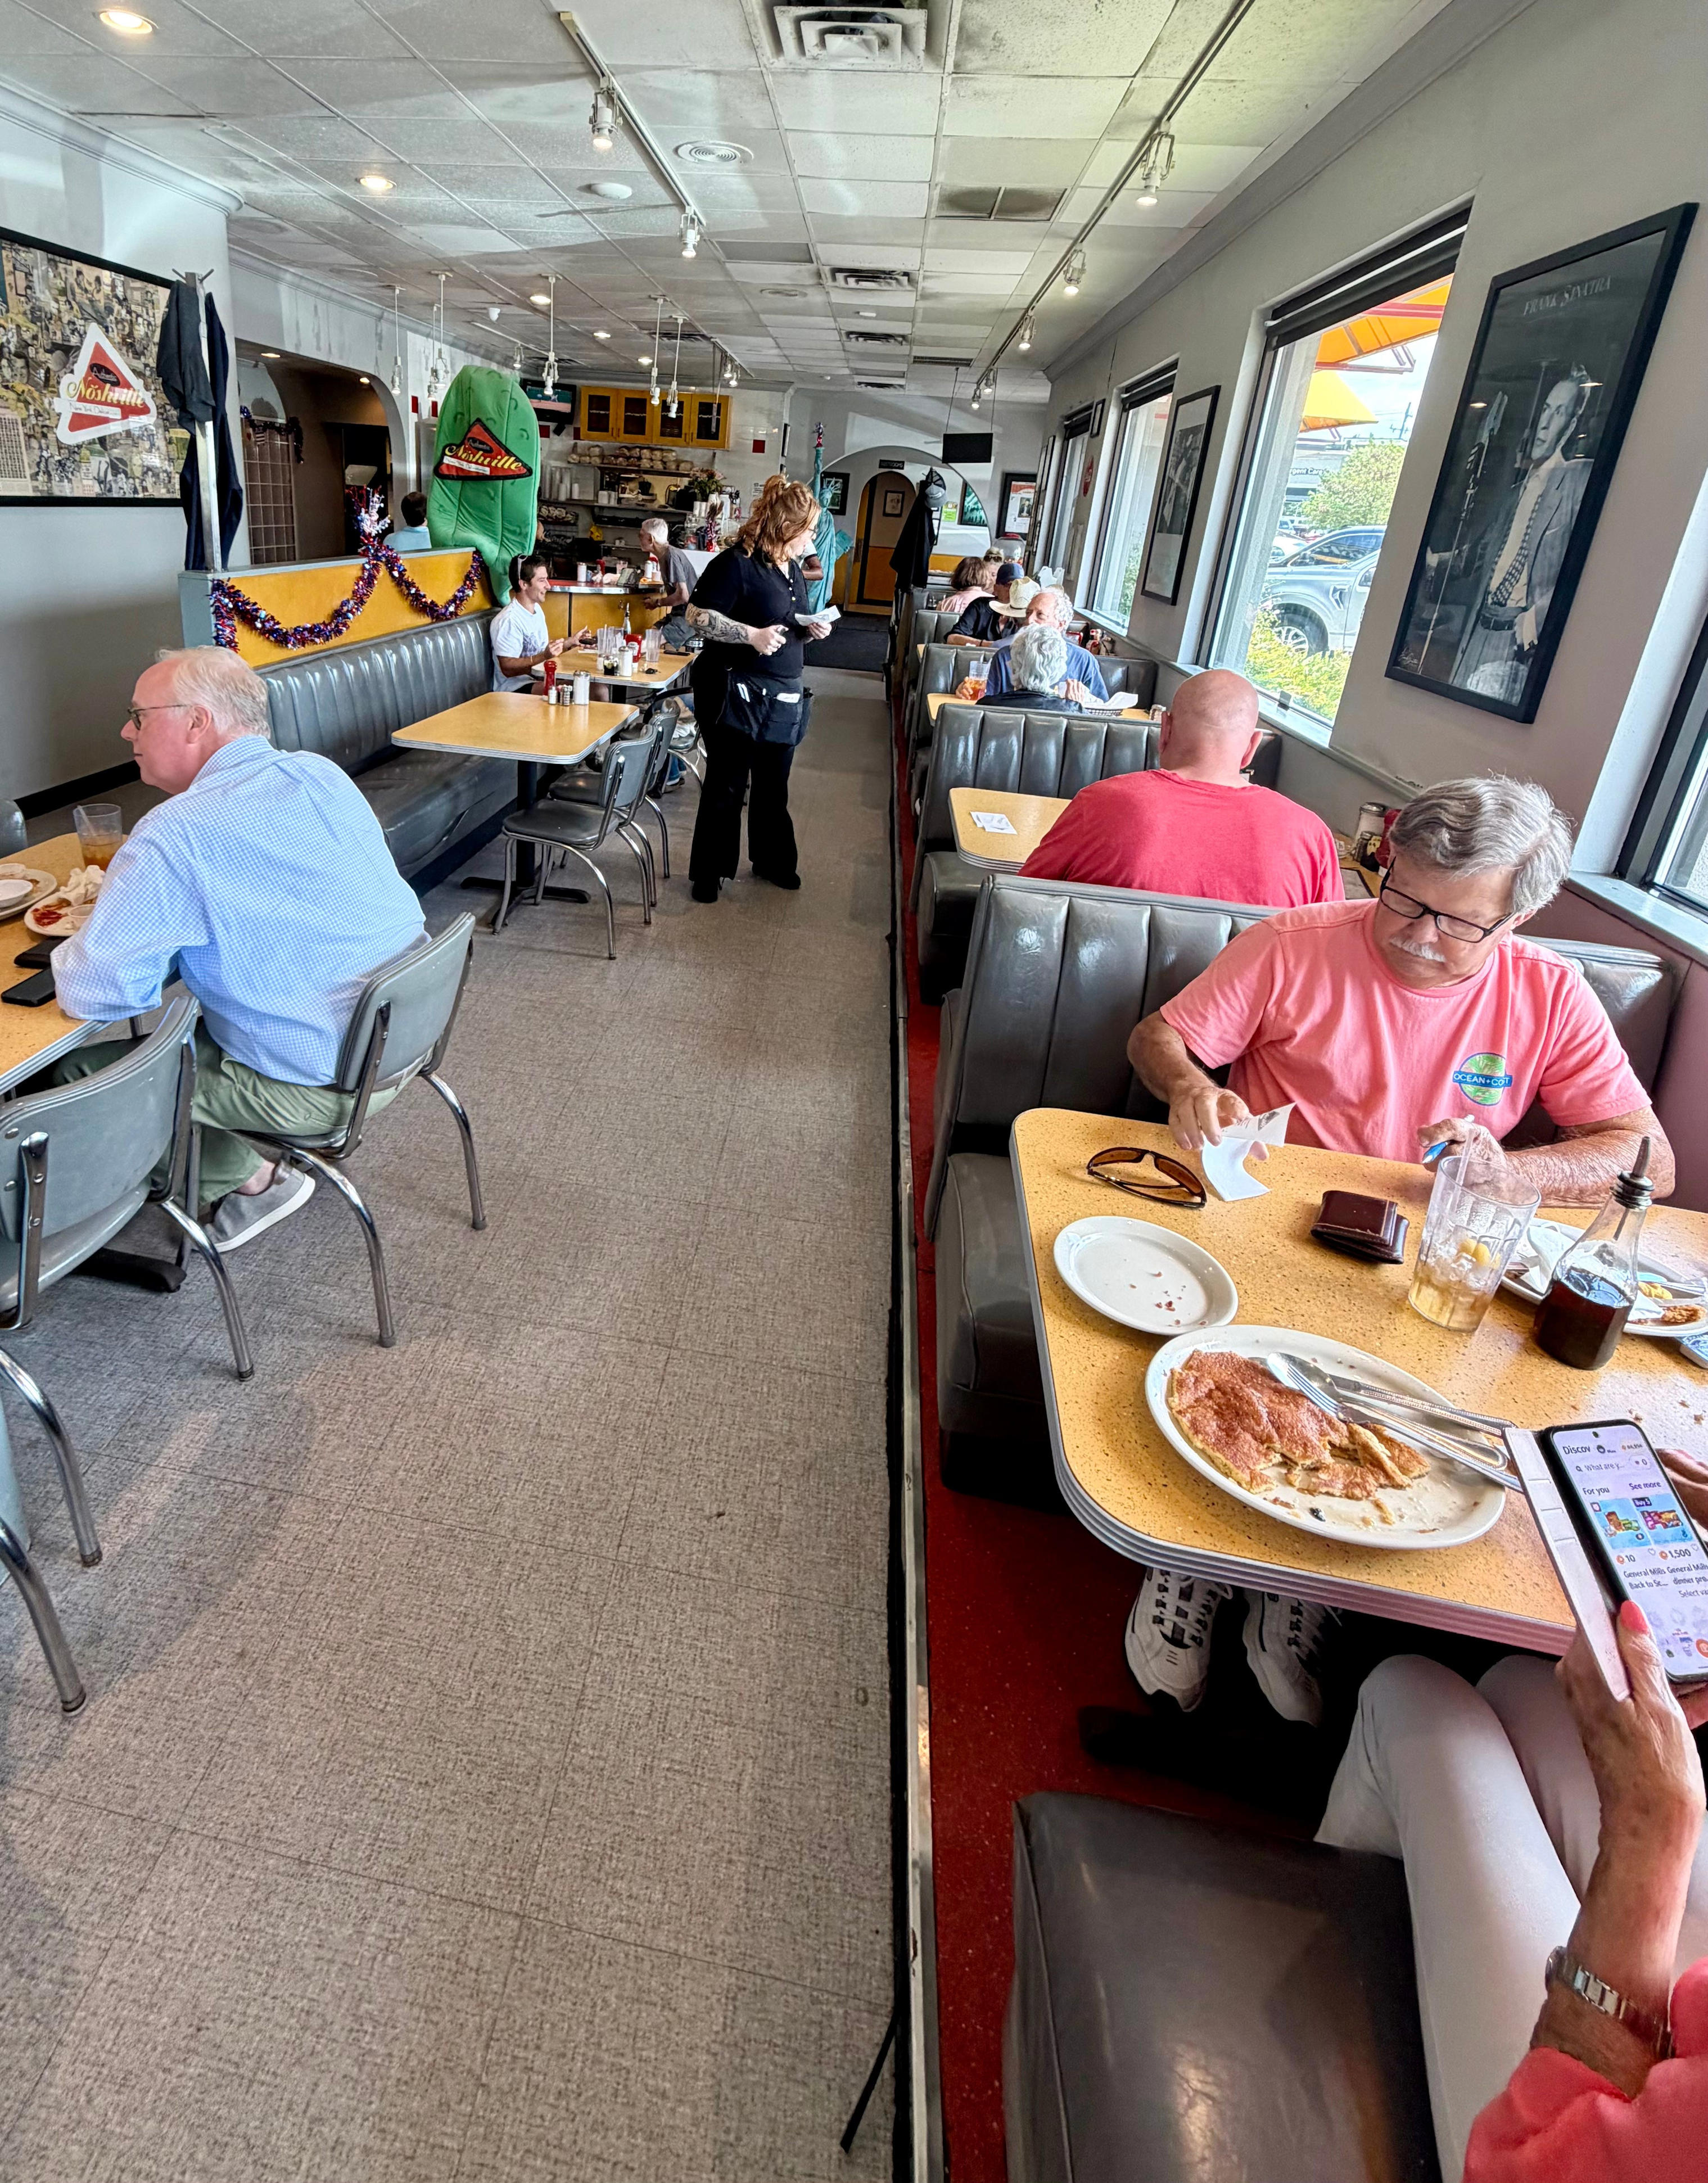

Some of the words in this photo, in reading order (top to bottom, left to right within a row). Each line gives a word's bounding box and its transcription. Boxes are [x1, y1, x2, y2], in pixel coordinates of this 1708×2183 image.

[1453, 1073, 1485, 1084] OCEAN
[1562, 1445, 1590, 1454] Discov
[1596, 1488, 1610, 1496] you
[1669, 1549, 1691, 1559] 1,500
[1666, 1563, 1693, 1573] General
[1624, 1569, 1650, 1578] General
